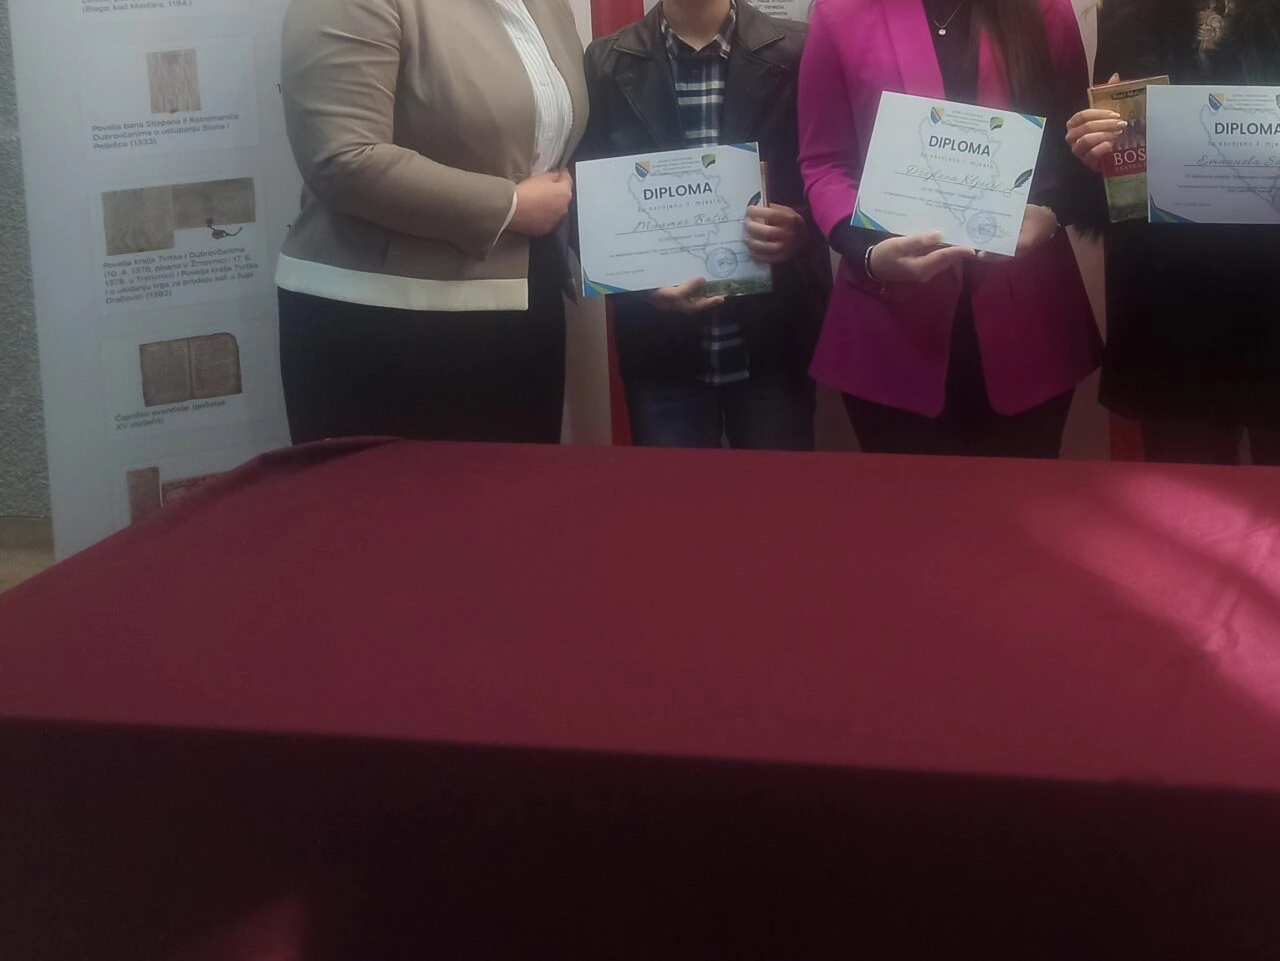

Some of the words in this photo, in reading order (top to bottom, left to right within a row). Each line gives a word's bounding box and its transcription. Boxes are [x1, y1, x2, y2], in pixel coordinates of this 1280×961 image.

[928, 135, 990, 157] DIPLOMA
[1113, 147, 1148, 167] BOS
[643, 182, 713, 201] DIPLOMA
